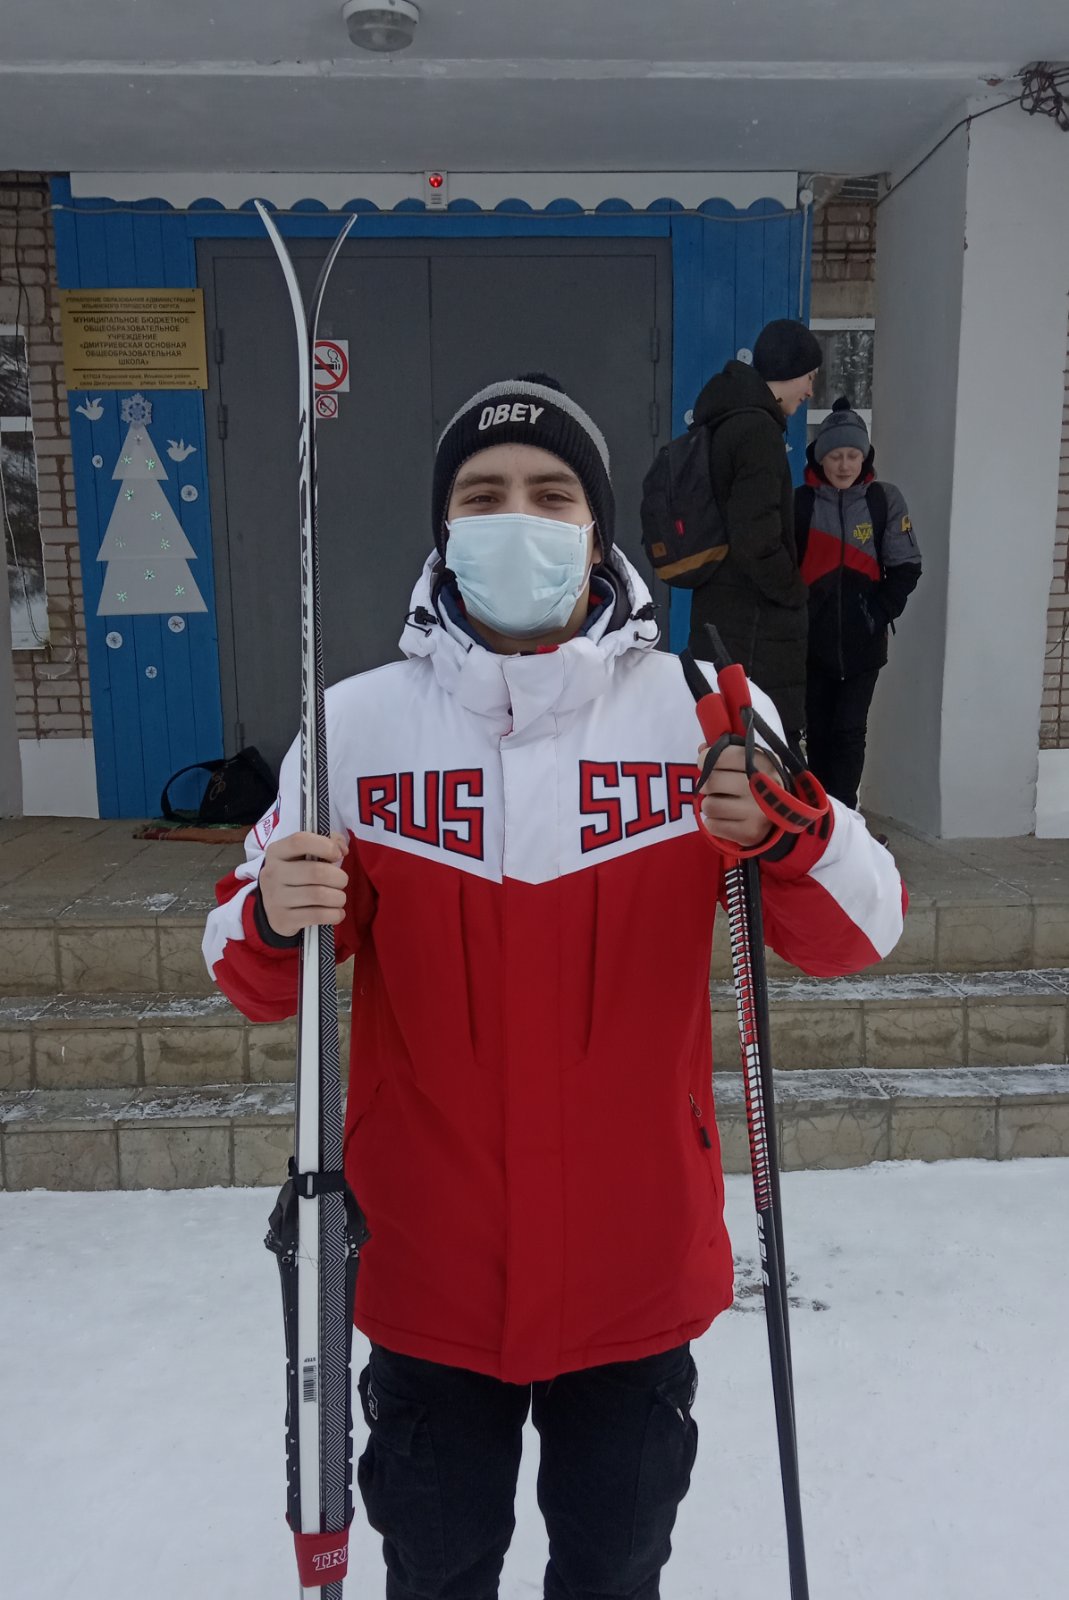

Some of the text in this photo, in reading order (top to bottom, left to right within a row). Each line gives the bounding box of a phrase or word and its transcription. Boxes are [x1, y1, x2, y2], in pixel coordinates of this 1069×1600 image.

[73, 316, 190, 324] МУНИЦИПАЛЬНОЕ БЮДЖЕТНОЕ
[83, 324, 180, 332] ОБЩЕОБРАЗОВАТЕЛЬНОЕ
[107, 333, 157, 341] УЧРЕЖДЕНИЕ
[80, 341, 187, 349] «ДМИТРИЕВСКАЯ ОСНОВНАЯ
[118, 358, 149, 366] ШКОЛА»
[478, 402, 544, 431] OBEY
[357, 767, 484, 861] RUS
